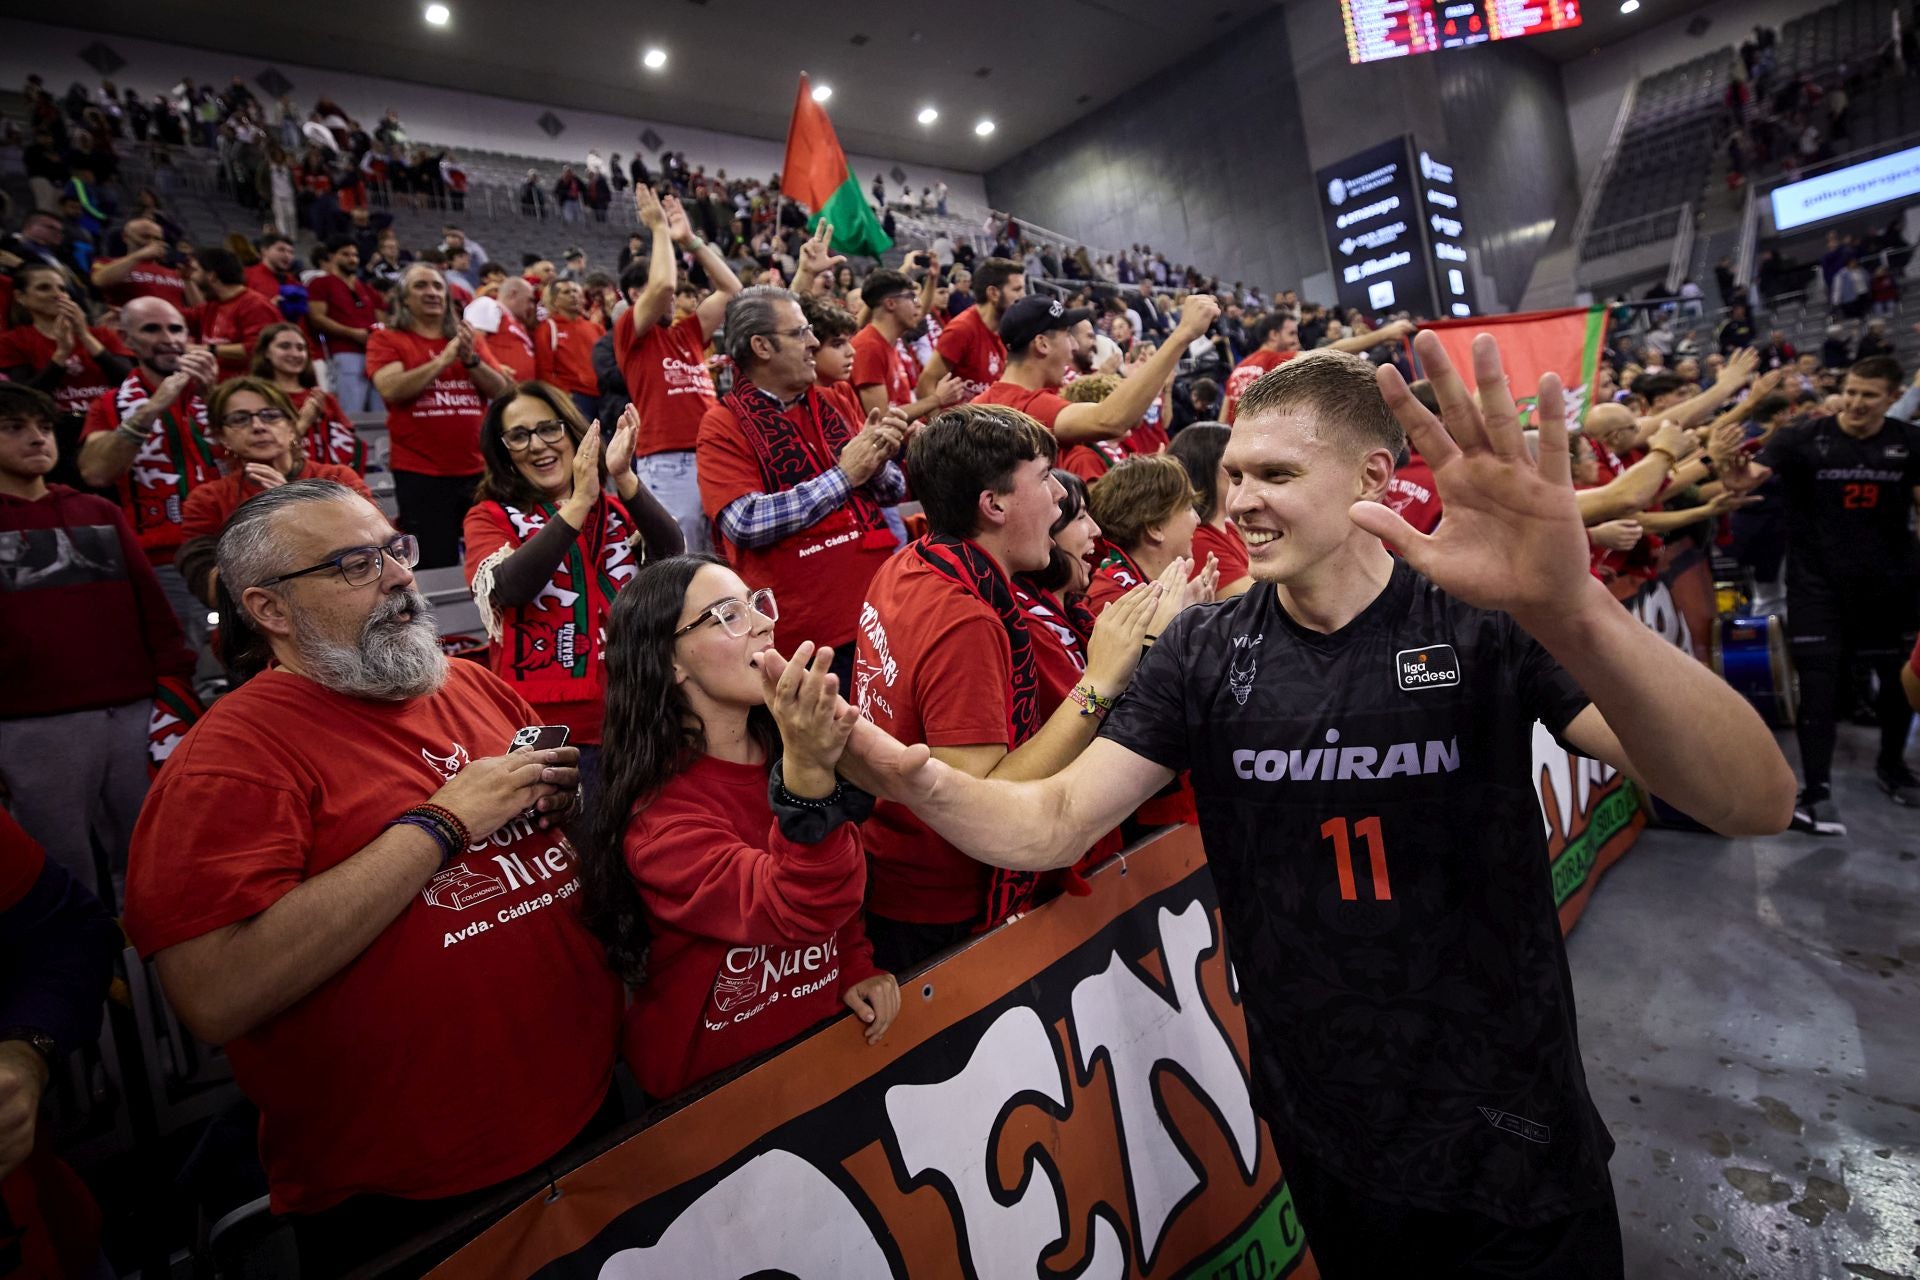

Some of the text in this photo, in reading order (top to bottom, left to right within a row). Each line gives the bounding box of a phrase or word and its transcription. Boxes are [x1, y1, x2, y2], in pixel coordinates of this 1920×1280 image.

[1843, 483, 1878, 510] 29
[799, 544, 824, 557] Avda.
[825, 534, 850, 548] Cádiz
[562, 623, 575, 668] GRANADA
[1403, 661, 1426, 675] liga
[1405, 669, 1456, 684] endesa
[872, 688, 894, 720] 2024
[491, 838, 576, 891] Nue
[1320, 816, 1392, 900] 11
[443, 920, 494, 948] Avda.
[497, 897, 540, 923] Cádiz
[734, 1003, 766, 1023] Cádiz
